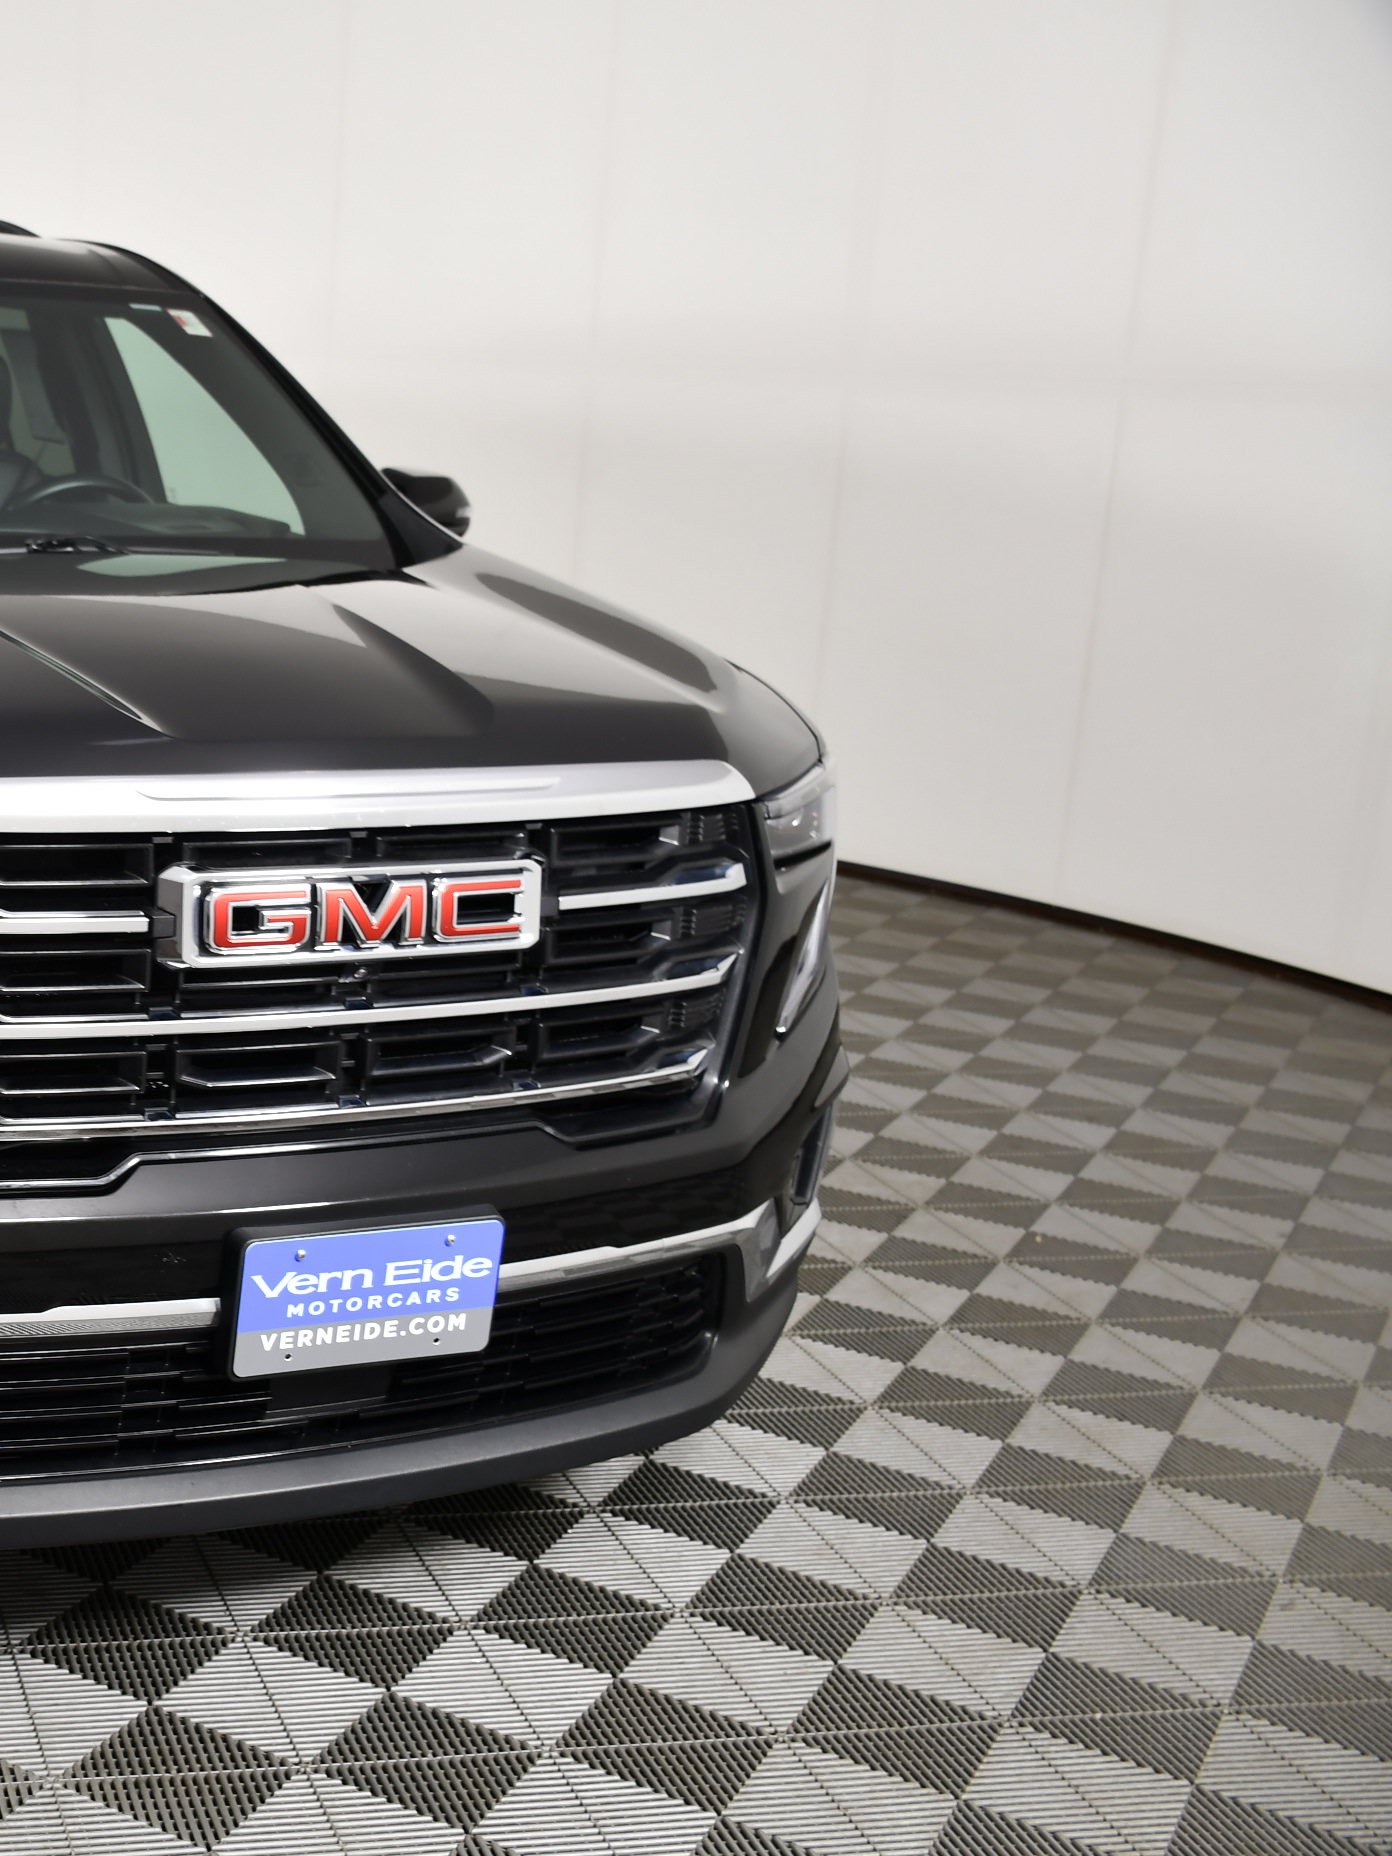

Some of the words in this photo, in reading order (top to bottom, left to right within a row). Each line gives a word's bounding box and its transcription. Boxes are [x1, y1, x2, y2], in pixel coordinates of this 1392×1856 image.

[207, 875, 523, 953] GMC
[251, 1268, 373, 1298] Vern
[383, 1255, 493, 1286] Eide
[286, 1286, 460, 1318] MOTORCARS
[260, 1313, 467, 1351] VERNEIDE.COM
